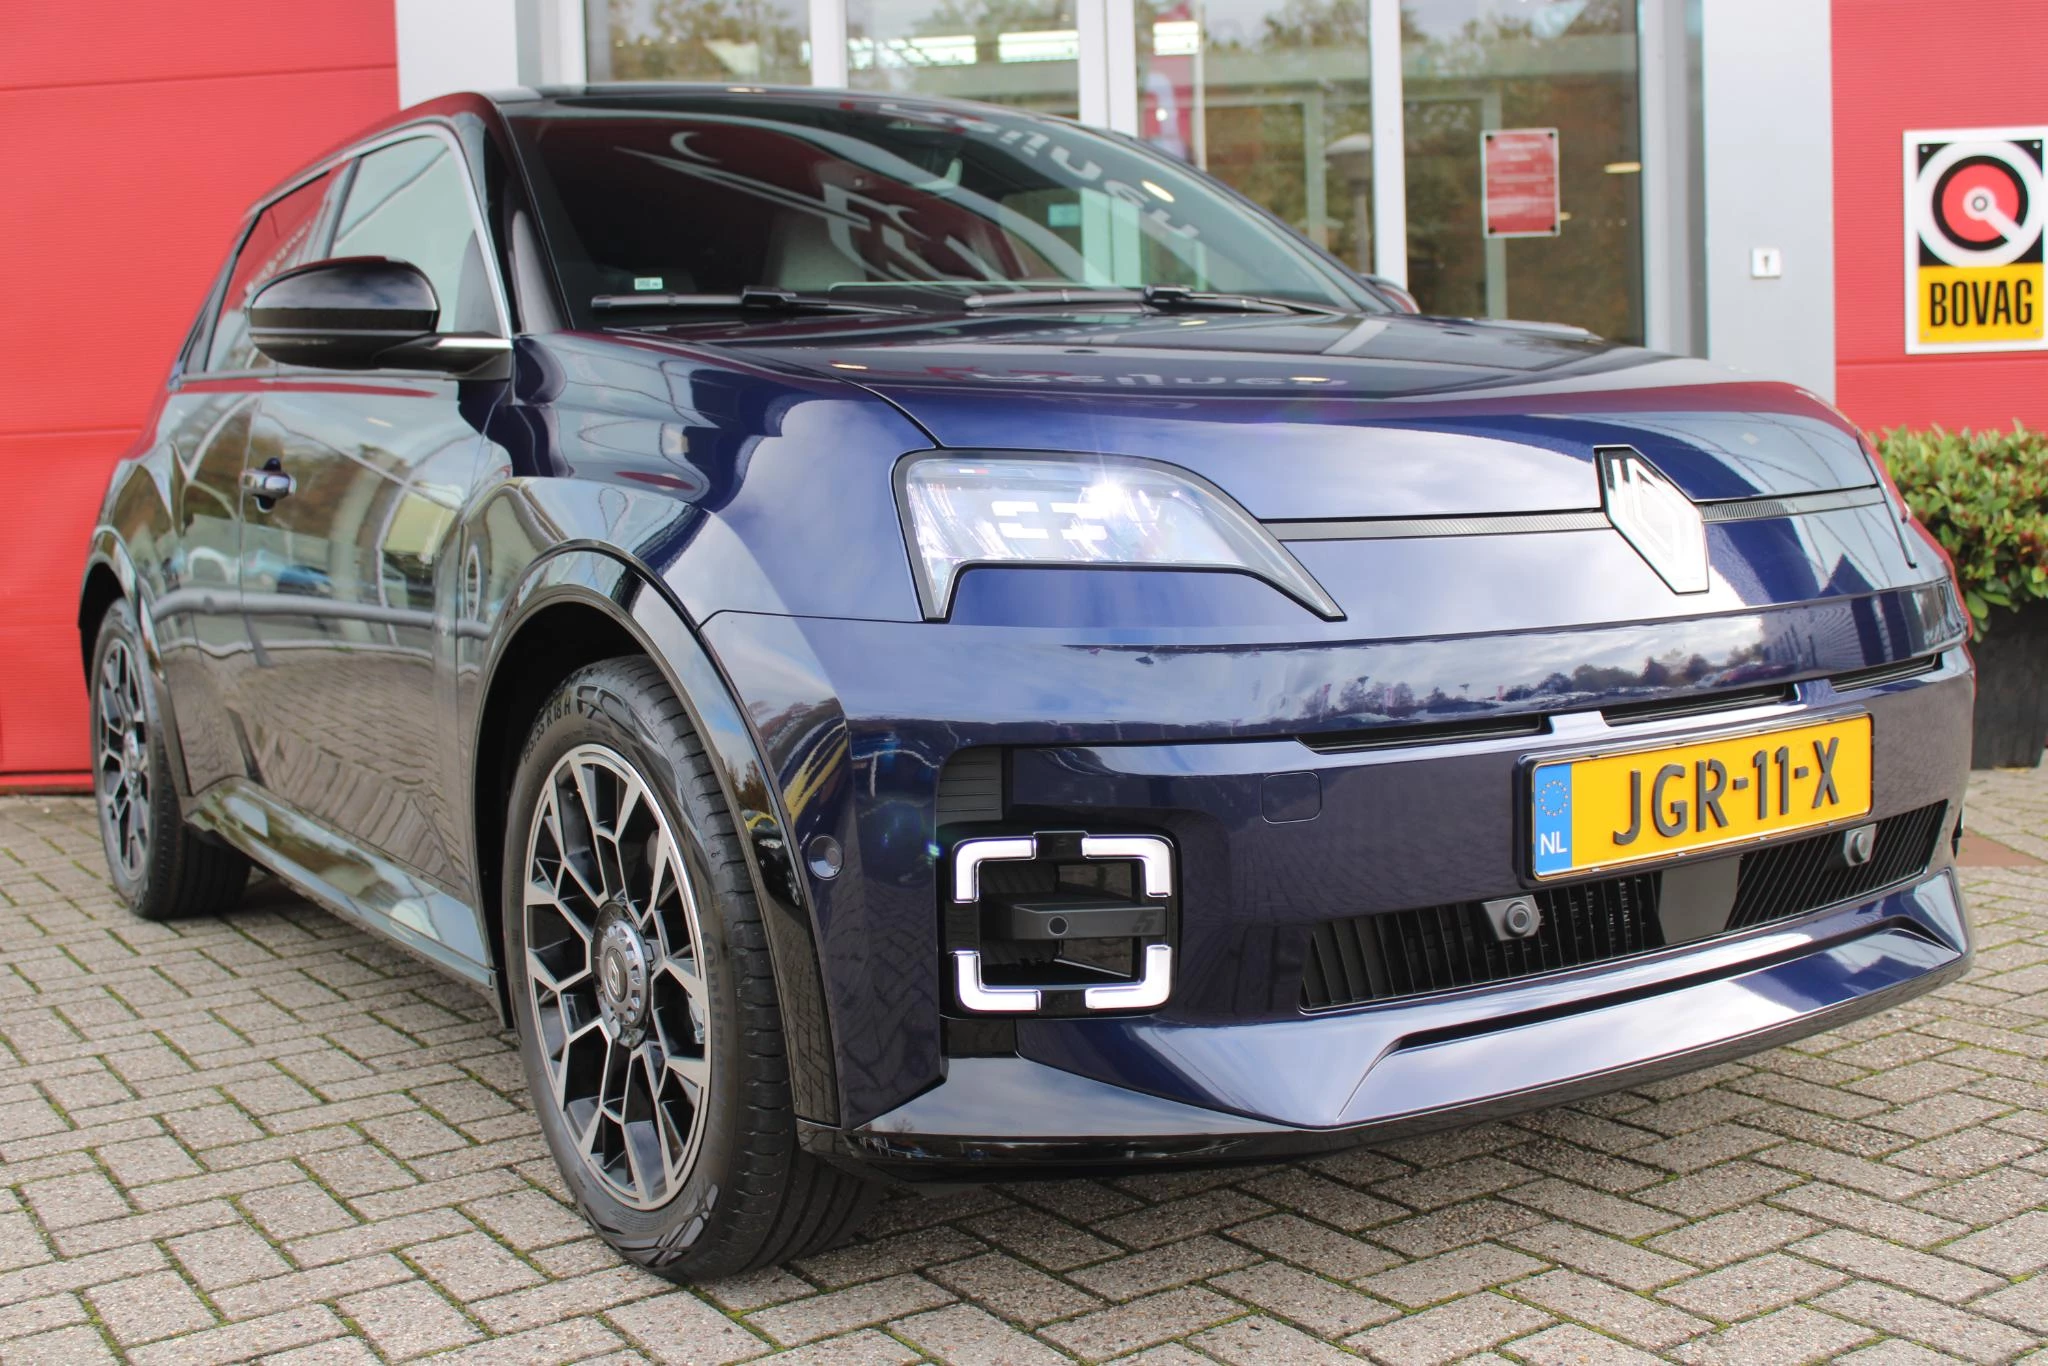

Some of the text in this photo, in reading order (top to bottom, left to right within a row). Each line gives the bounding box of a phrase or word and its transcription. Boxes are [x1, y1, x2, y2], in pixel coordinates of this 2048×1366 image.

[1930, 279, 2033, 327] BOVAG
[1613, 737, 1840, 846] JGR-11-X
[1540, 831, 1567, 856] NL
